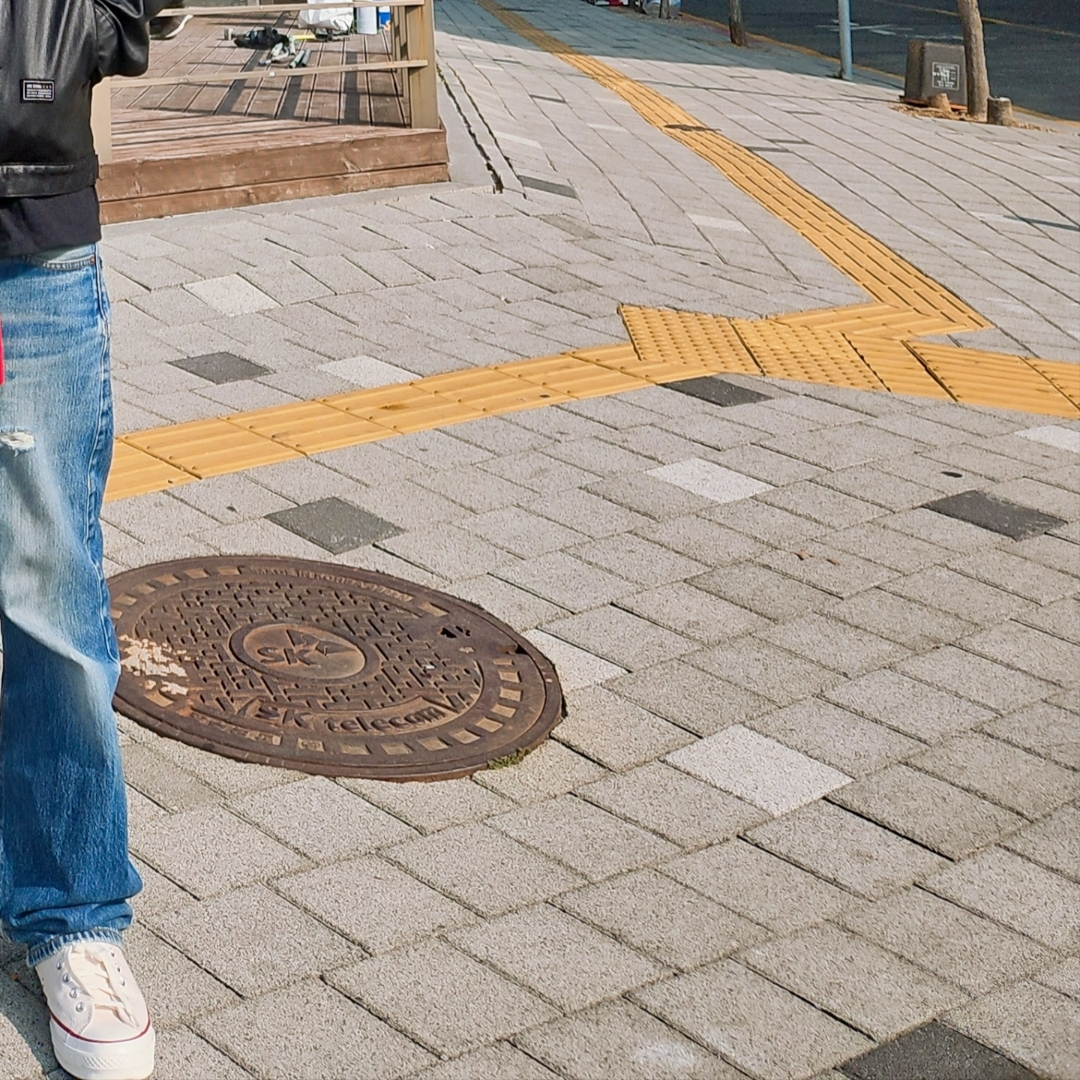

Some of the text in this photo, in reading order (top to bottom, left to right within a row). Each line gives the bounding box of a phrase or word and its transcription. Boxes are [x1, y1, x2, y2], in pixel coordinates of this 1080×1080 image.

[257, 644, 314, 667] SK
[254, 704, 313, 731] SK
[323, 704, 448, 734] telecom
